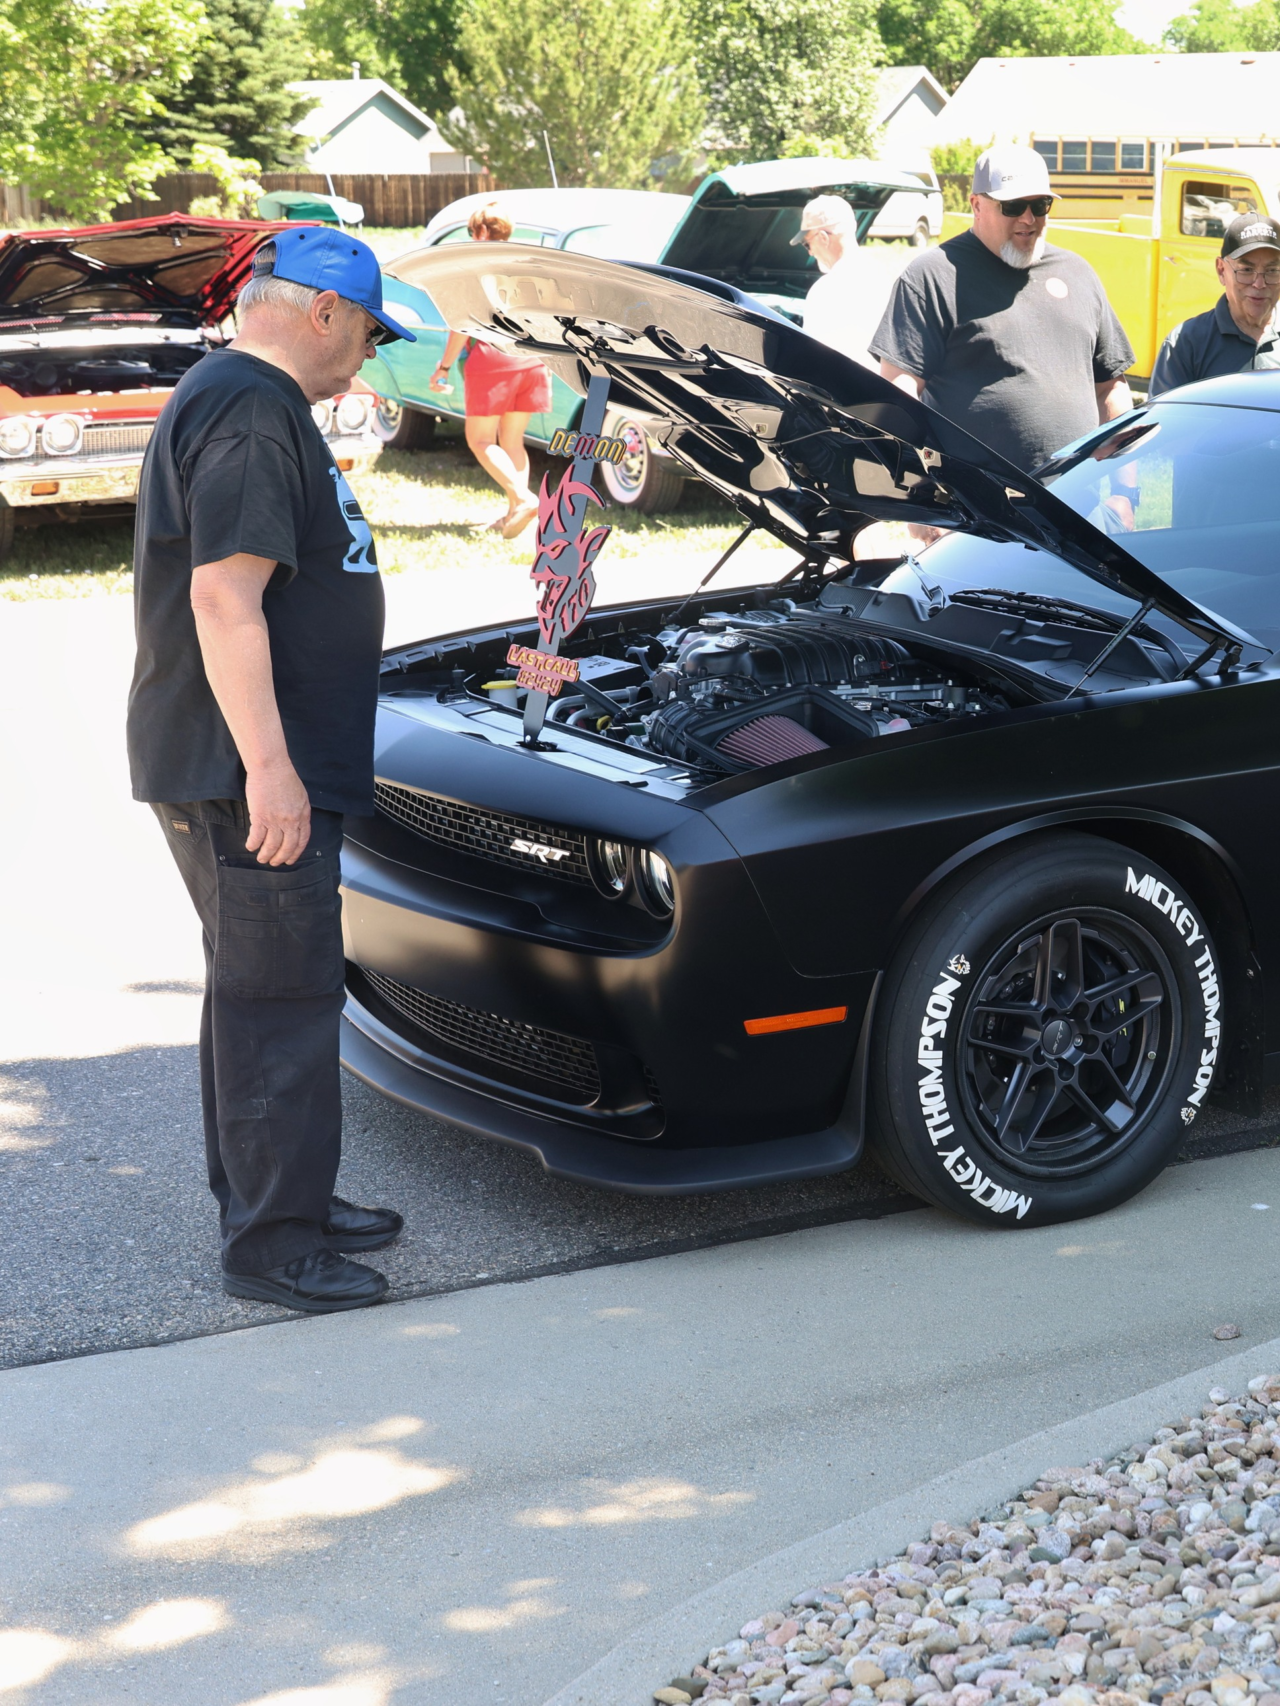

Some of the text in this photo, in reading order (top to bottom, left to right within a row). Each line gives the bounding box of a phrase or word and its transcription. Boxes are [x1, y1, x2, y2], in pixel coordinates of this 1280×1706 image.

[549, 430, 623, 462] DEMON
[509, 648, 544, 671] LAST
[544, 658, 577, 678] CALL
[509, 839, 572, 864] SRT
[1125, 866, 1221, 1108] MICKEY THOMPSON
[917, 972, 1033, 1220] MICKEY THOMPSON
